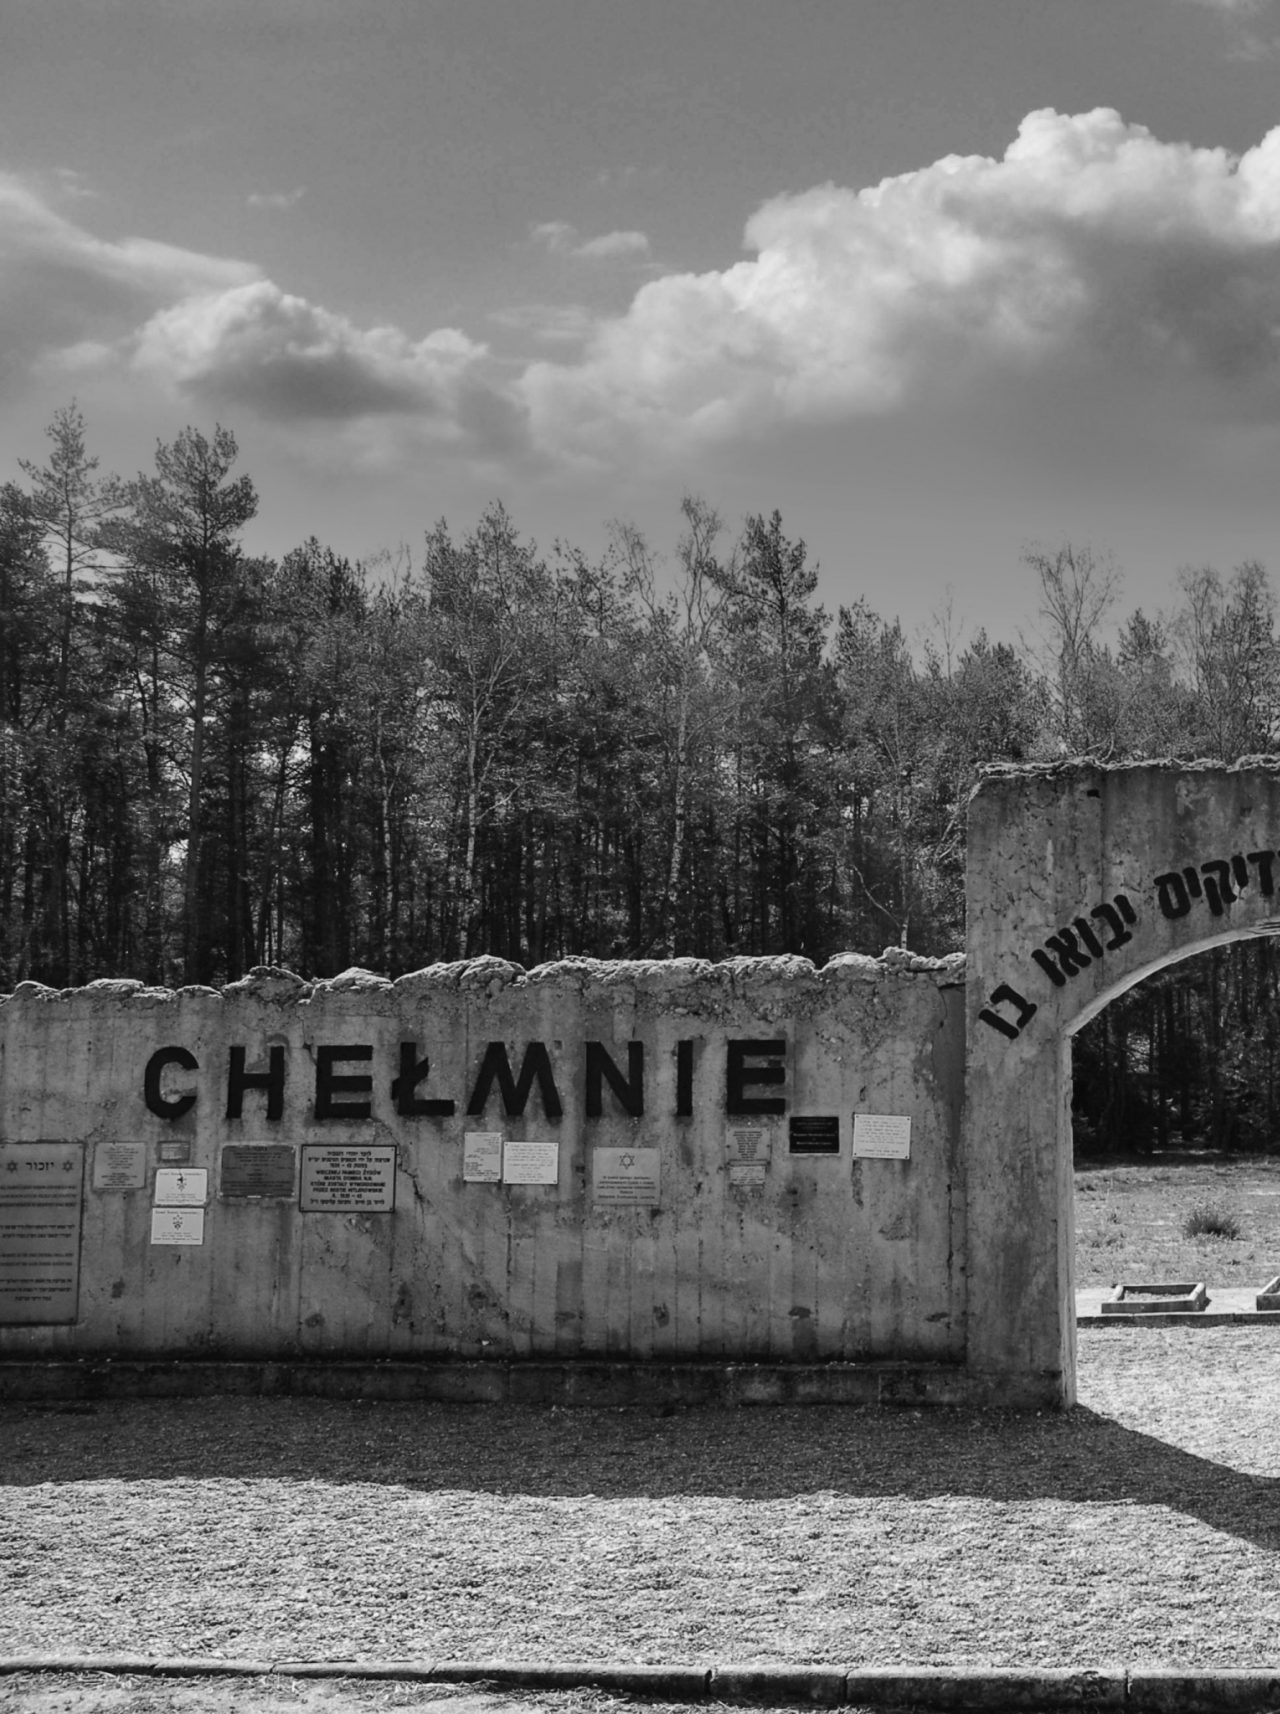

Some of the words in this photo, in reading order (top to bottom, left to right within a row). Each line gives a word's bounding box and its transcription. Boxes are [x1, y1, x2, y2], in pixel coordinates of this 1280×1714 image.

[1031, 893, 1137, 988] יבואו
[978, 983, 1038, 1040] בו
[144, 1040, 788, 1122] CHEŁMNIE
[25, 1160, 55, 1171] יזכור
